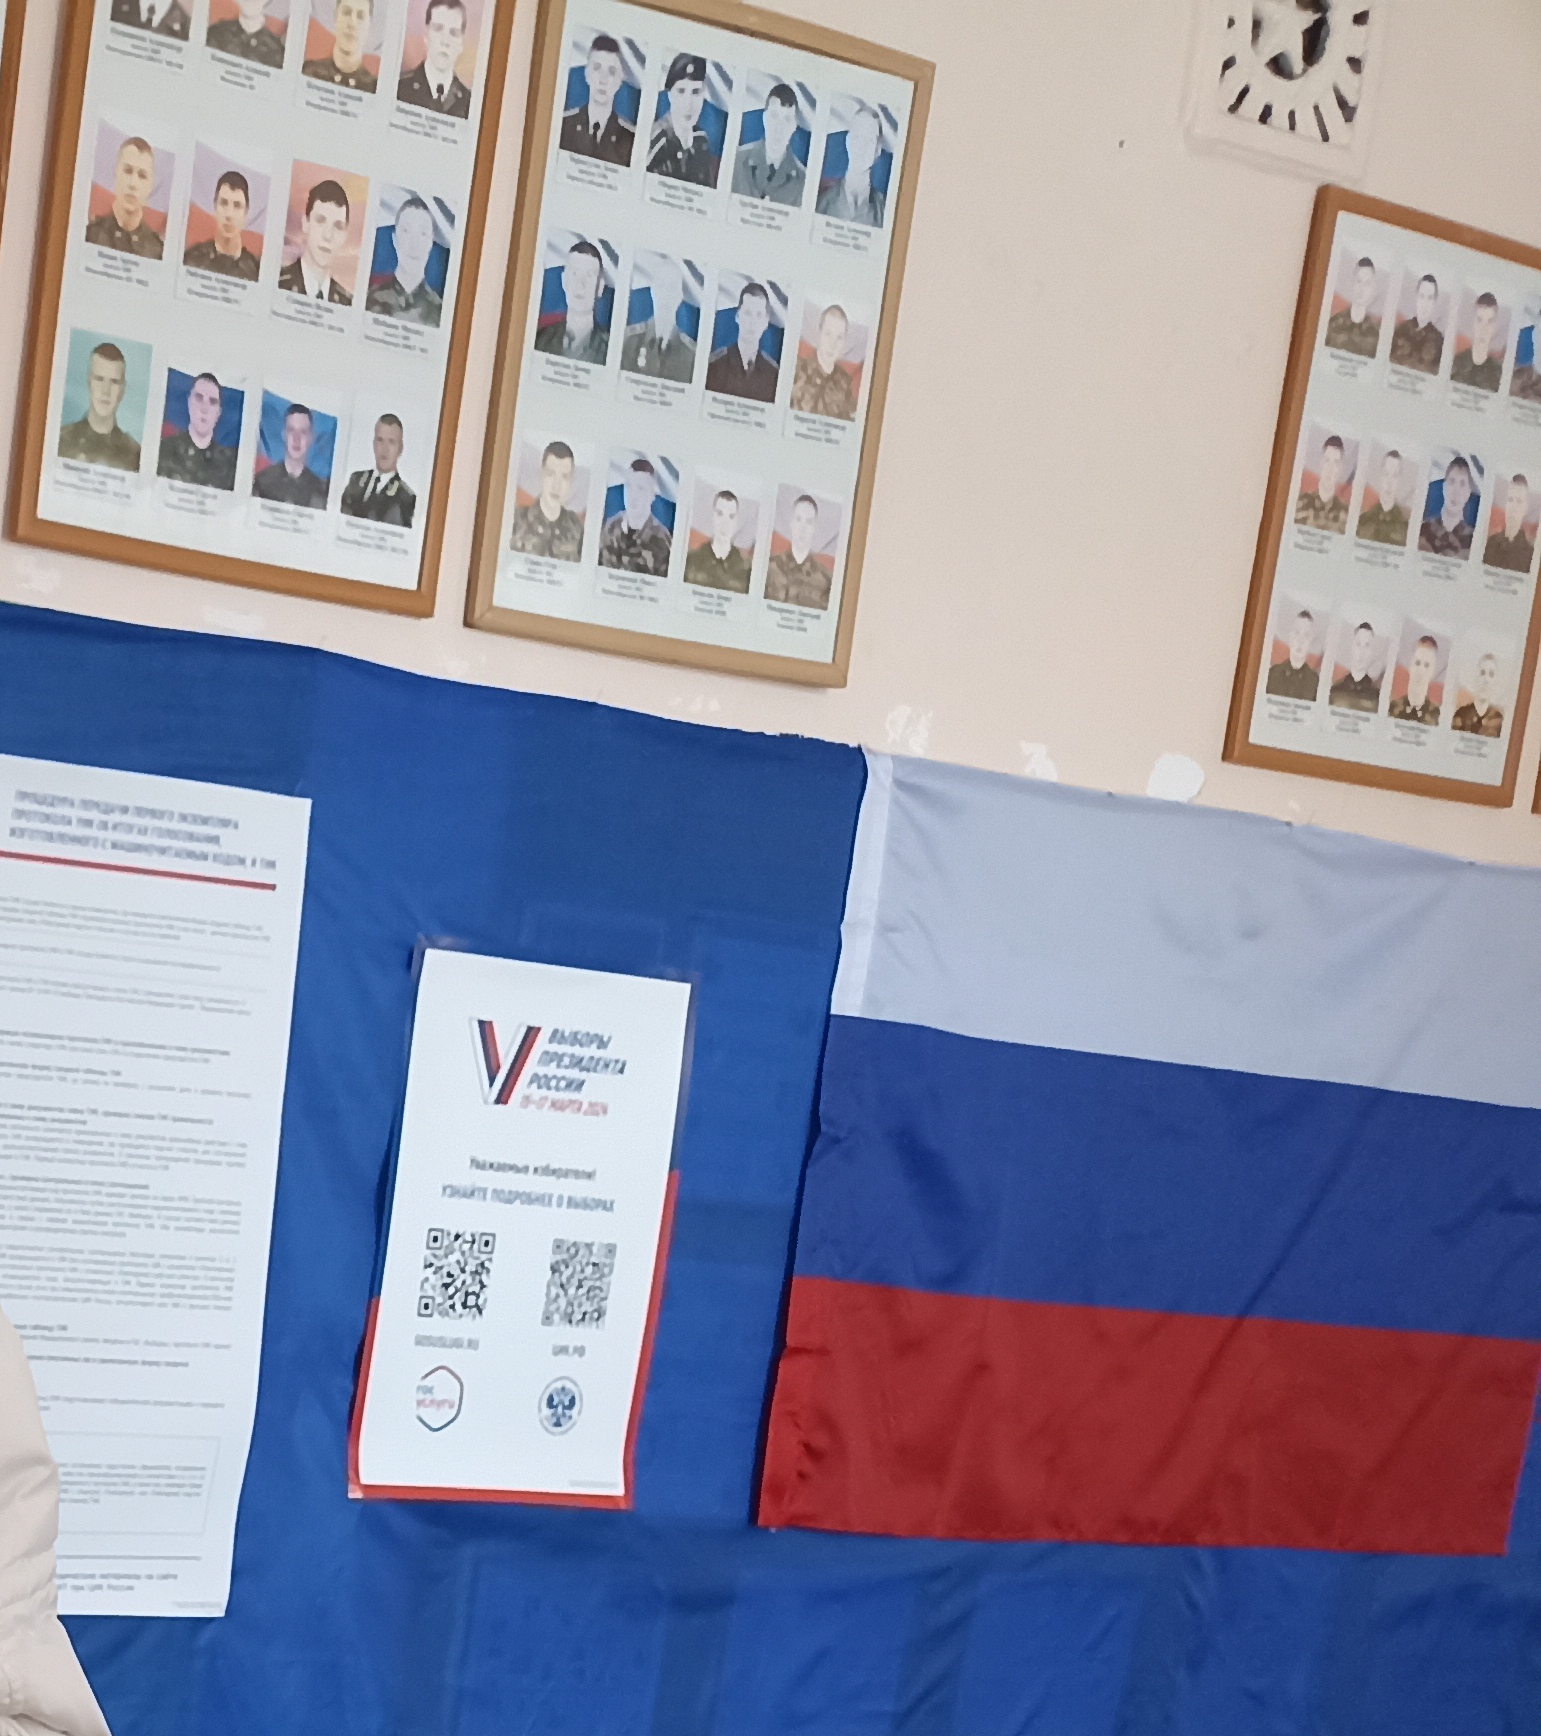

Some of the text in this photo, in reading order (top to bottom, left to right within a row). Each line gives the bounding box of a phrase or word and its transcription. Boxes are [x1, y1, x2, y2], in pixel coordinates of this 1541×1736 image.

[548, 1028, 612, 1050] ВЫБОРЫ
[537, 1050, 627, 1075] ПРЕЗИДЕНТА
[527, 1072, 586, 1094] РОССИИ
[469, 1155, 529, 1174] Уважаемые
[490, 1187, 553, 1208] ПОДРОБНЕЕ
